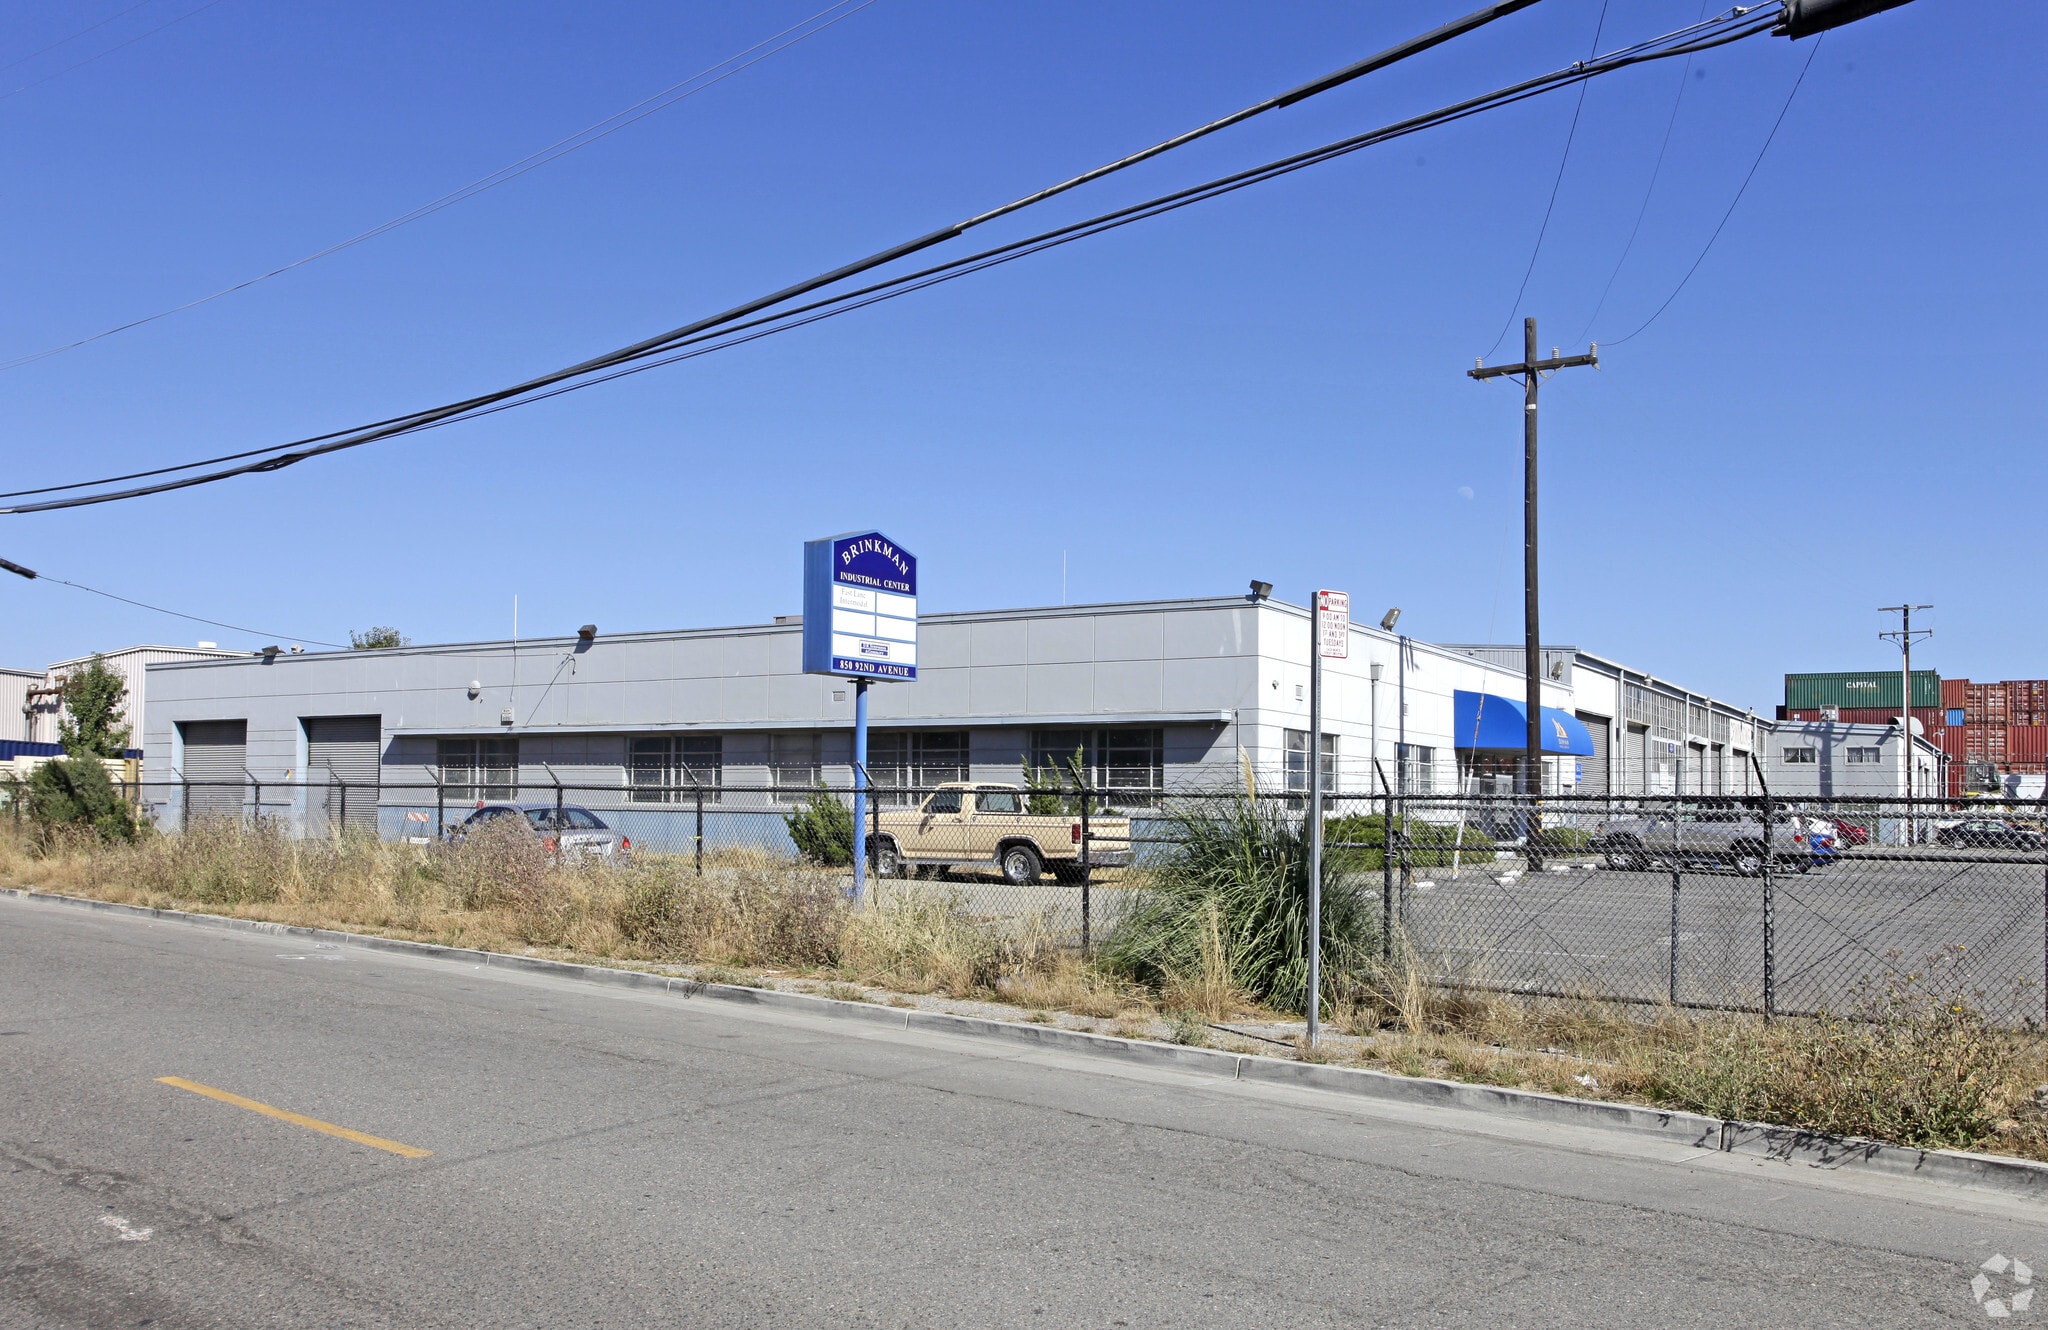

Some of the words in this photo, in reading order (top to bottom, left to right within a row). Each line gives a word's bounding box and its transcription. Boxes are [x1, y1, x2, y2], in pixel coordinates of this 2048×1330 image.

[841, 538, 909, 576] BRINKMAN
[840, 571, 882, 587] INDUSTRIAL
[883, 579, 910, 592] CENTER
[1329, 597, 1347, 608] PARKING
[1329, 630, 1338, 638] AND
[839, 659, 853, 670] 850
[855, 661, 875, 673] 92ND
[877, 663, 909, 677] AVENUE
[1846, 681, 1877, 689] CAPITAL
